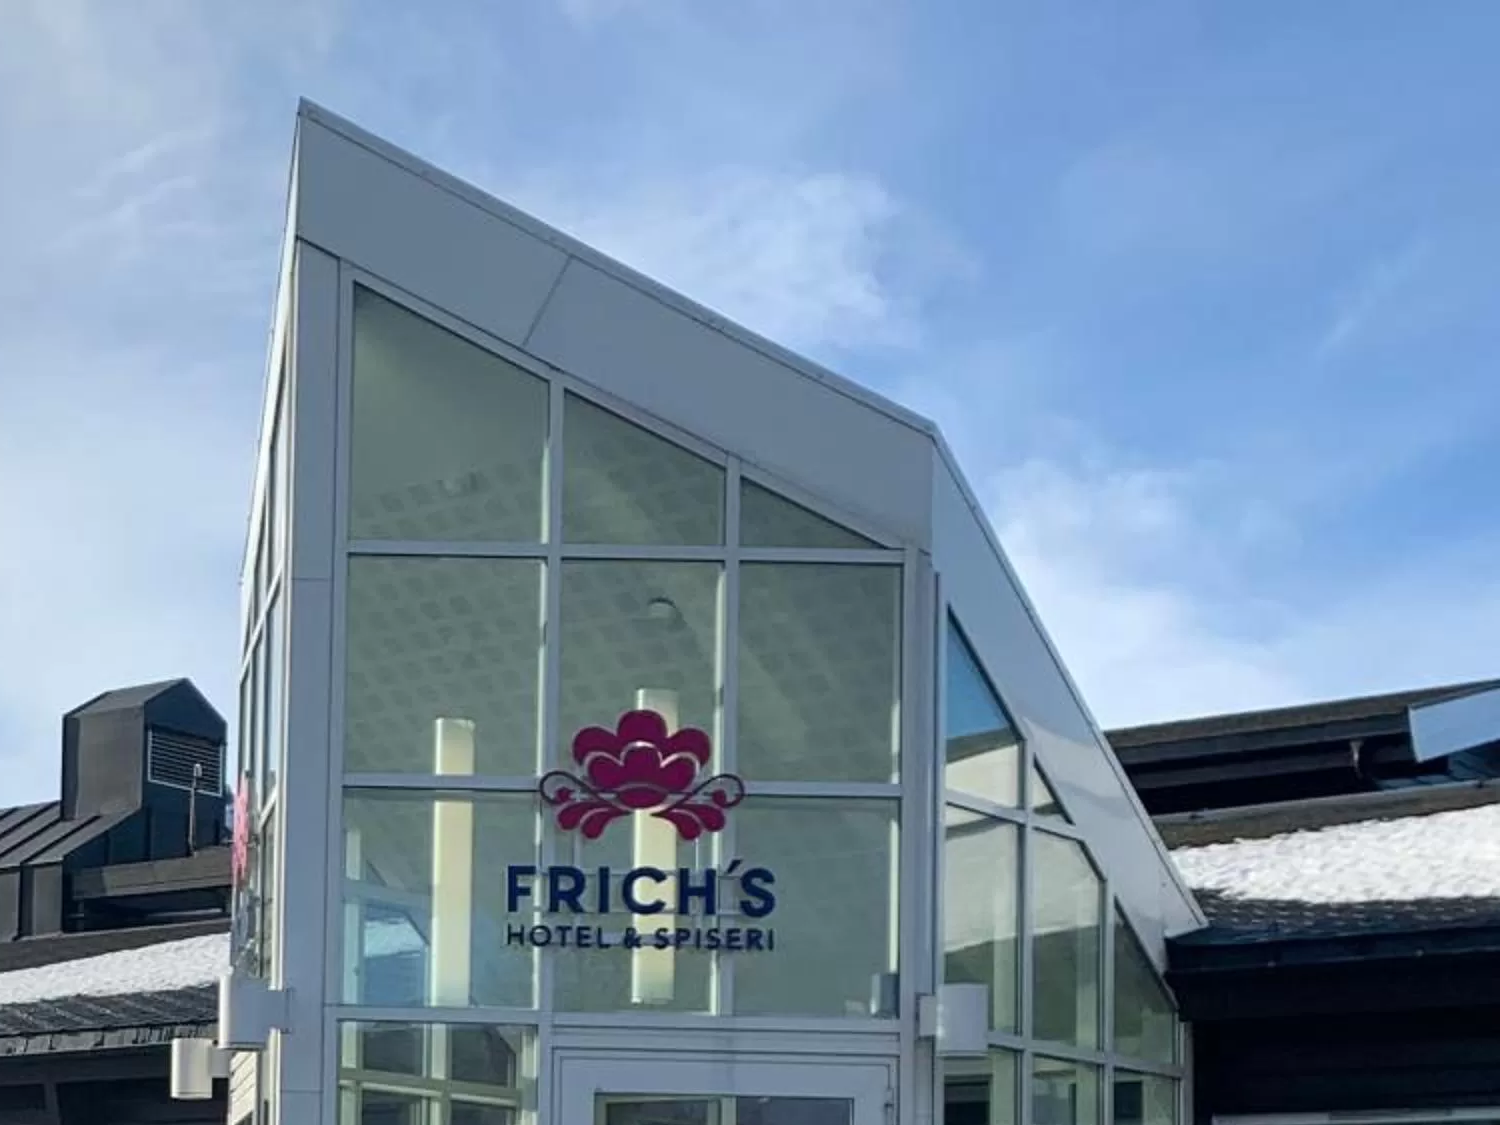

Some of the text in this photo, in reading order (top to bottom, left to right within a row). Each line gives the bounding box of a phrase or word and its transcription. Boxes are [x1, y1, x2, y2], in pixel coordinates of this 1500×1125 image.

[506, 924, 774, 952] HOTEL & SPISERI
